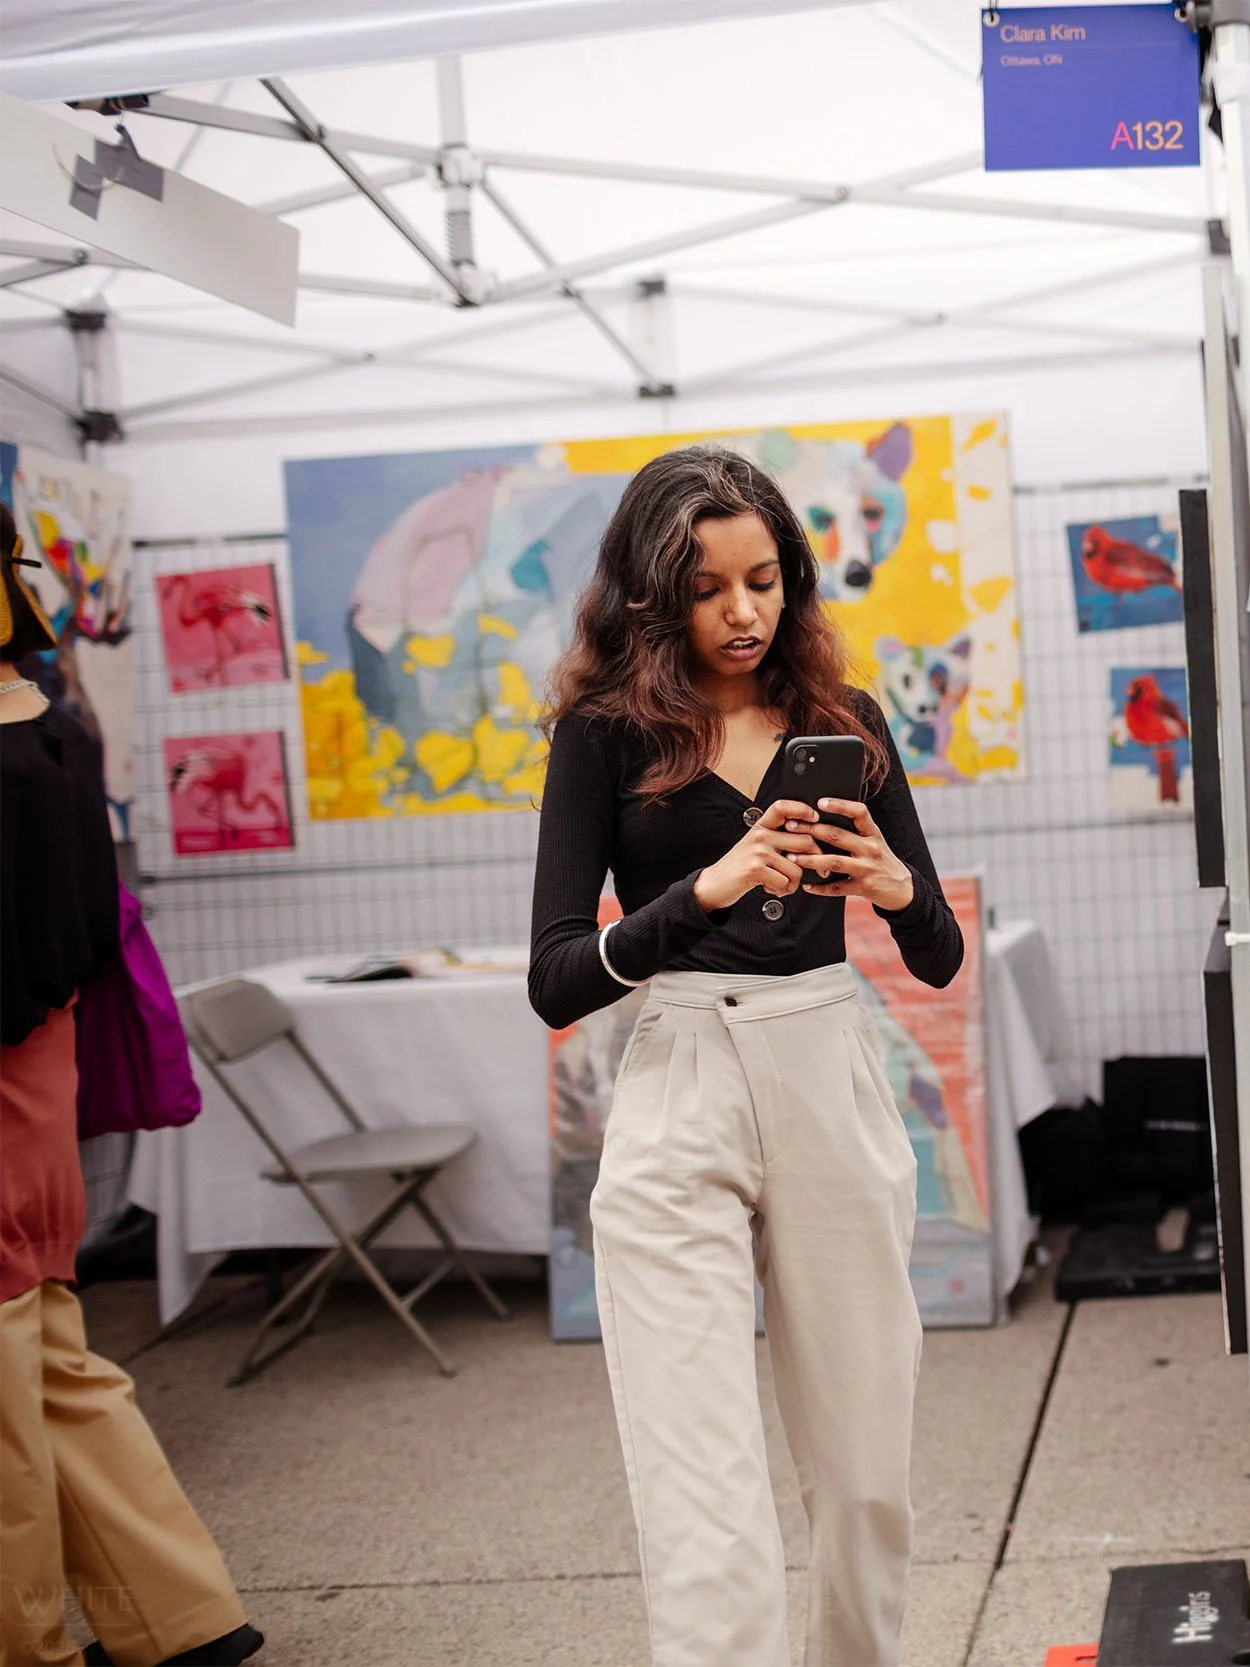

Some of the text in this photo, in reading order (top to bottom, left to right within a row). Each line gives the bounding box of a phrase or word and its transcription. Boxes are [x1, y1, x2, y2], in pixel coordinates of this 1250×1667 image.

[1001, 24, 1086, 43] Clara Kim
[1043, 54, 1063, 66] ON
[1111, 120, 1183, 151] A132
[1172, 1591, 1220, 1643] Higgins
